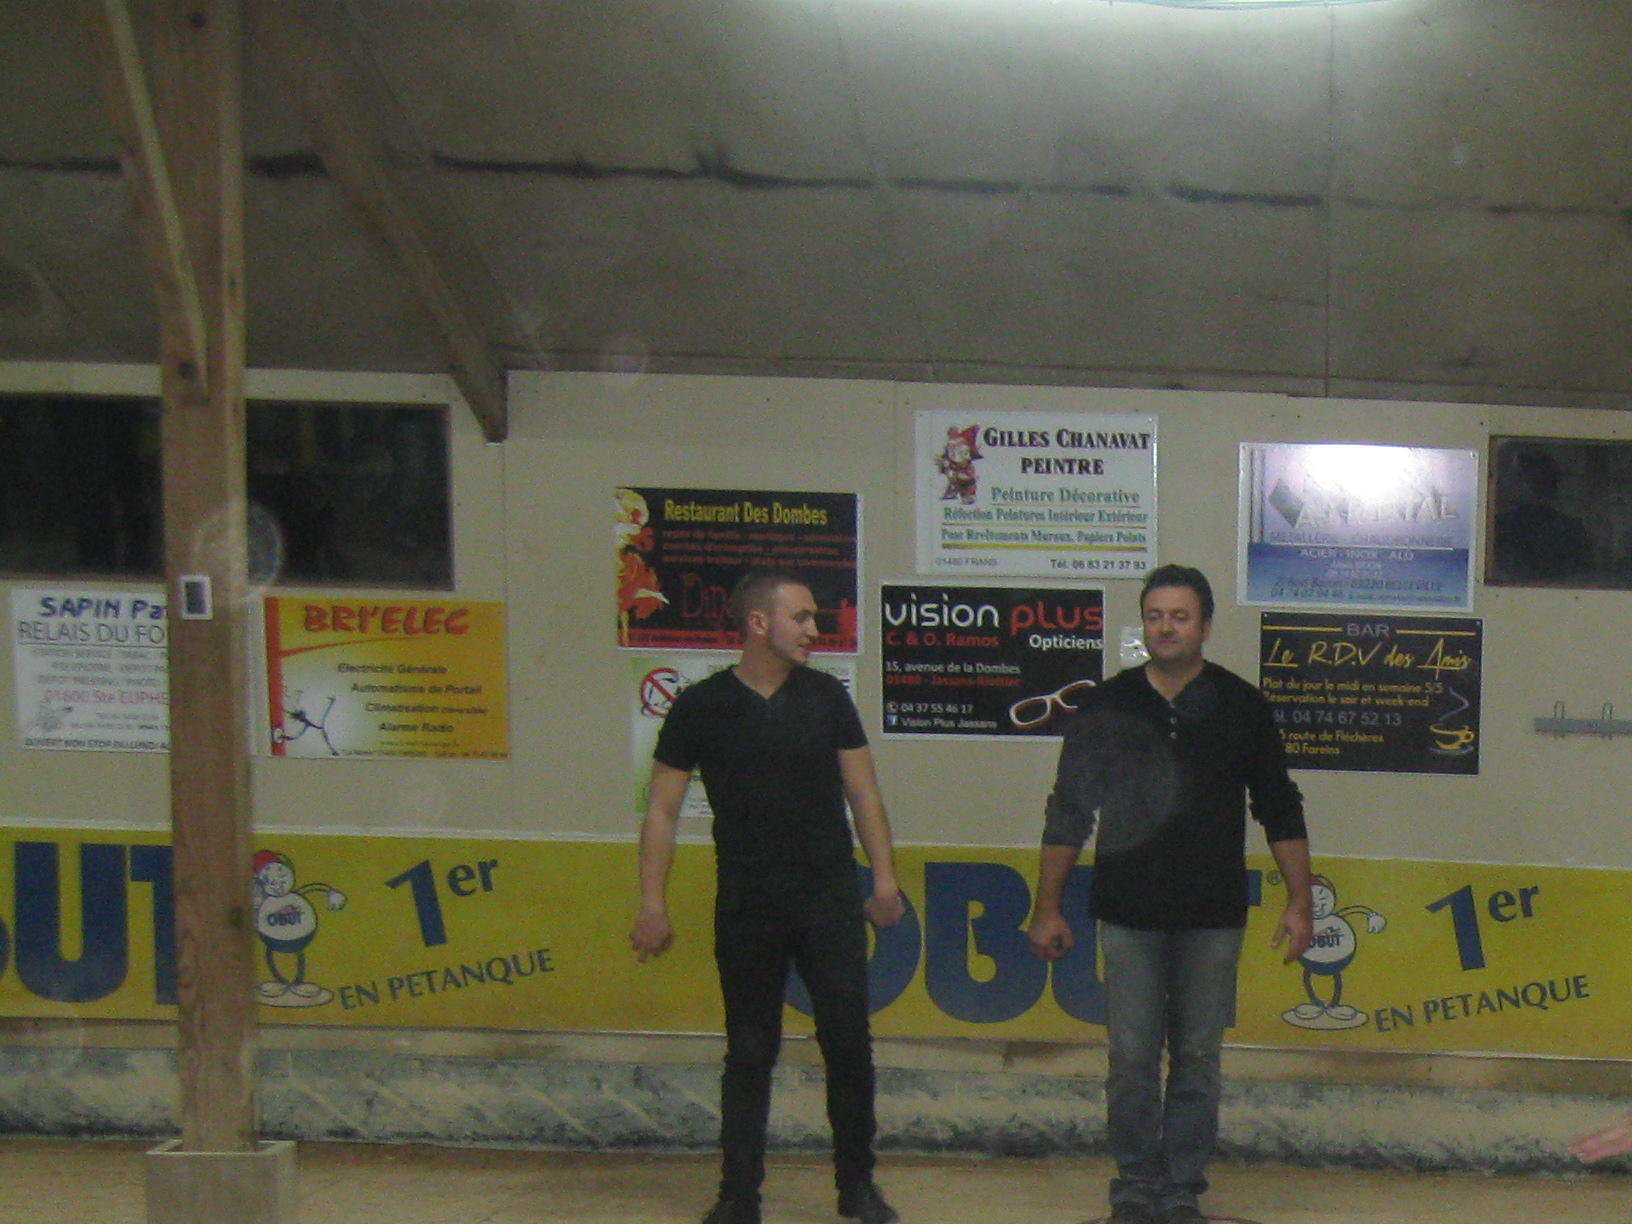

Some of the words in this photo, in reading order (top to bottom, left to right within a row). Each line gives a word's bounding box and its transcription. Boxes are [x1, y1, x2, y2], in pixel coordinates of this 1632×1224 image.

[983, 427, 1049, 448] GILLES
[1056, 428, 1151, 450] CHANAVAT
[1020, 457, 1105, 476] PEINTRE
[991, 486, 1055, 501] Peinture
[1059, 487, 1140, 504] Décorative
[664, 499, 740, 522] Restaurant
[744, 501, 769, 524] Des
[772, 502, 829, 526] Dombes
[944, 507, 993, 521] Réfection
[1049, 509, 1095, 523] Intérieur
[1098, 510, 1149, 523] Extérieur
[39, 597, 121, 619] SAPIN
[131, 599, 167, 620] Pa
[884, 592, 1000, 628] vision
[1010, 601, 1103, 636] plus
[304, 604, 470, 635] BRI'ELEC
[17, 620, 92, 642] RELAIS
[98, 623, 129, 643] DU
[135, 624, 166, 644] FO
[905, 631, 920, 646] &
[945, 631, 1000, 648] Ramos
[1346, 622, 1390, 638] BAR
[1029, 634, 1104, 651] Opticiens
[905, 663, 945, 674] avenue
[947, 661, 961, 674] de
[963, 662, 973, 674] la
[976, 662, 1022, 675] Dombes
[1264, 638, 1298, 667] Le
[1384, 646, 1416, 668] des
[1418, 637, 1472, 681] Amis
[1263, 677, 1284, 689] Plat
[1286, 676, 1301, 689] du
[1301, 680, 1325, 692] jour
[1325, 678, 1335, 690] le
[1336, 680, 1361, 691] midi
[1361, 683, 1377, 692] en
[1378, 684, 1423, 693] semaine
[901, 702, 913, 714] 04
[916, 703, 929, 714] 37
[1292, 710, 1311, 724] 04
[1316, 711, 1334, 724] 74
[1338, 711, 1356, 725] 67
[1361, 712, 1379, 725] 52
[1384, 712, 1402, 726] 13
[422, 723, 454, 733] Radio
[1288, 731, 1317, 741] route
[1319, 729, 1334, 742] de
[385, 858, 498, 949] 1er
[0, 841, 178, 1005] UT
[267, 908, 304, 927] OBUT
[1425, 884, 1539, 972] 1er
[338, 981, 381, 1010] EN
[386, 948, 555, 1002] PETANQUE
[1374, 1005, 1415, 1033] EN
[1423, 974, 1590, 1025] PETANQUE
